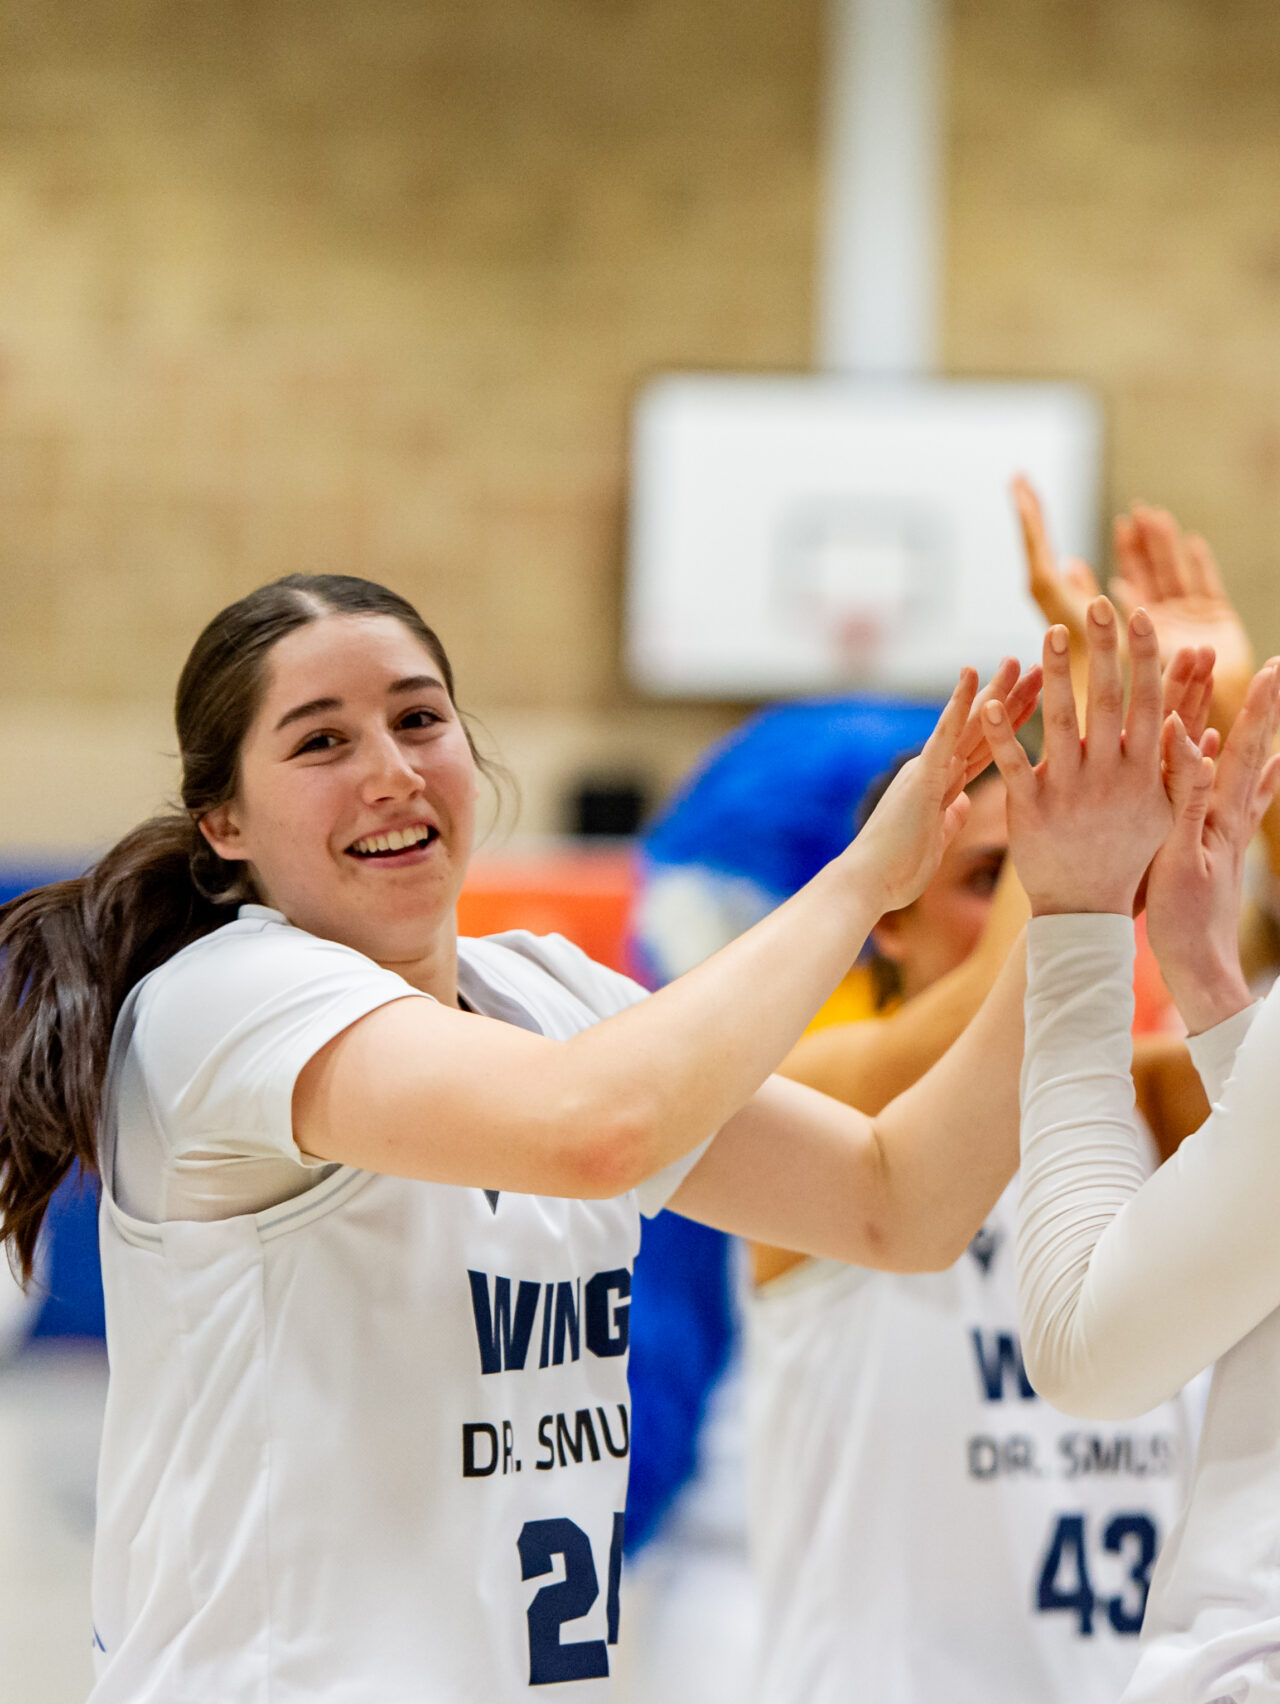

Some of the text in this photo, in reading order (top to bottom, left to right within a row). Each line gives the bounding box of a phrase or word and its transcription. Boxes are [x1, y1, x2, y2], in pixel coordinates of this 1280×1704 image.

[467, 1267, 632, 1375] WING
[462, 1403, 630, 1478] DR. SMU
[516, 1511, 625, 1686] 2
[1034, 1511, 1158, 1638] 43
